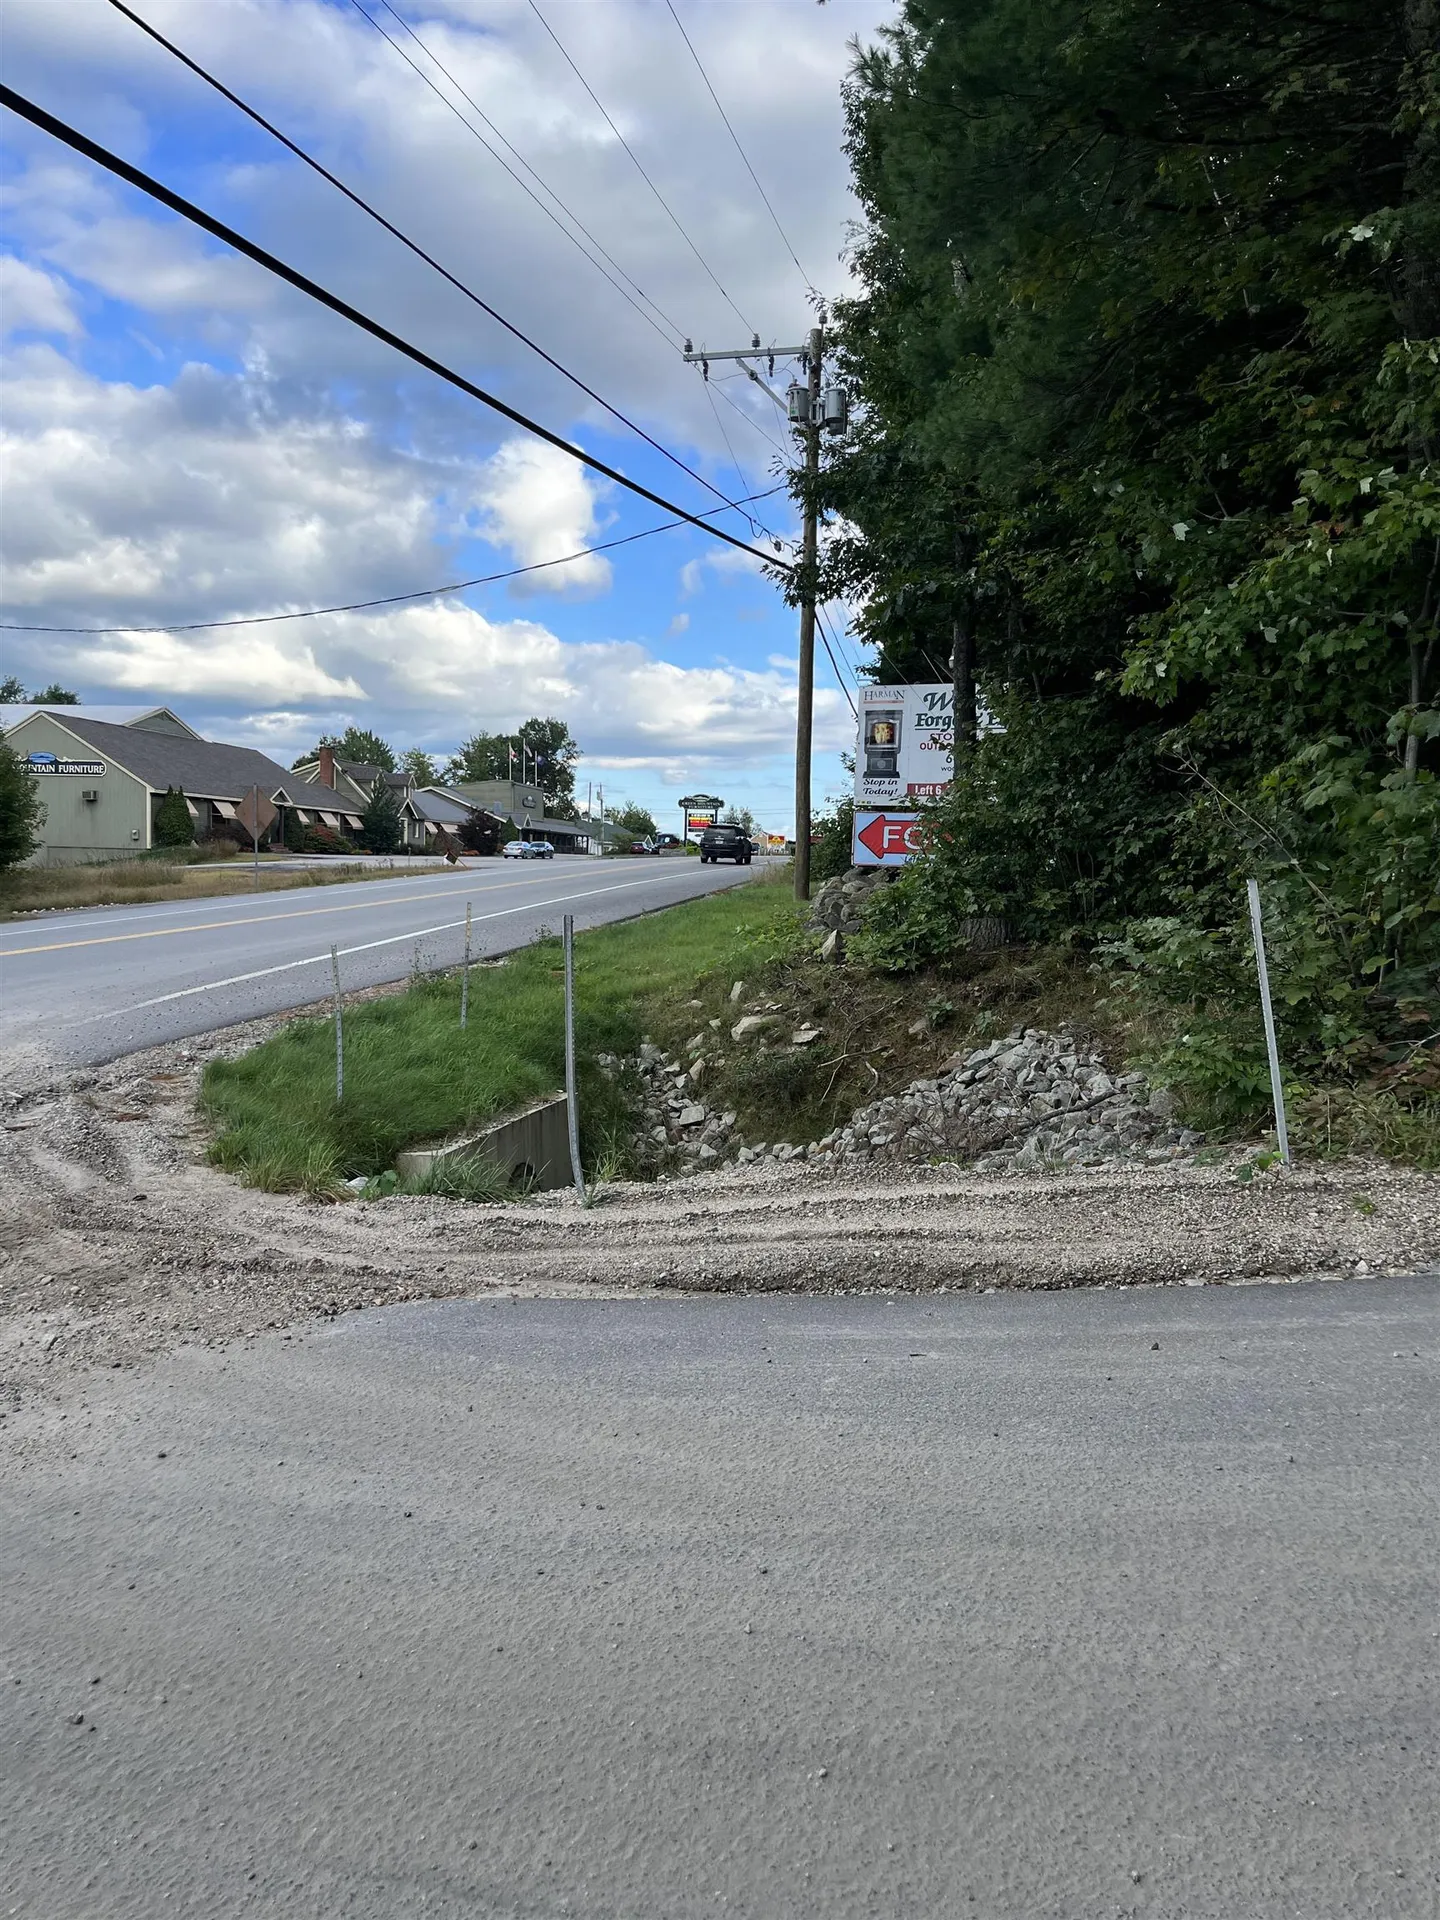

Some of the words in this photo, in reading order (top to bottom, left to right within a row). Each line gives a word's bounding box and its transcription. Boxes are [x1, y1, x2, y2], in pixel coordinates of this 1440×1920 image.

[864, 690, 905, 700] HARMAN
[915, 713, 955, 732] Forg
[930, 733, 955, 741] STO
[58, 765, 104, 773] FURNITURE
[863, 778, 885, 787] Stop
[863, 787, 898, 796] Today!
[915, 785, 933, 795] Left
